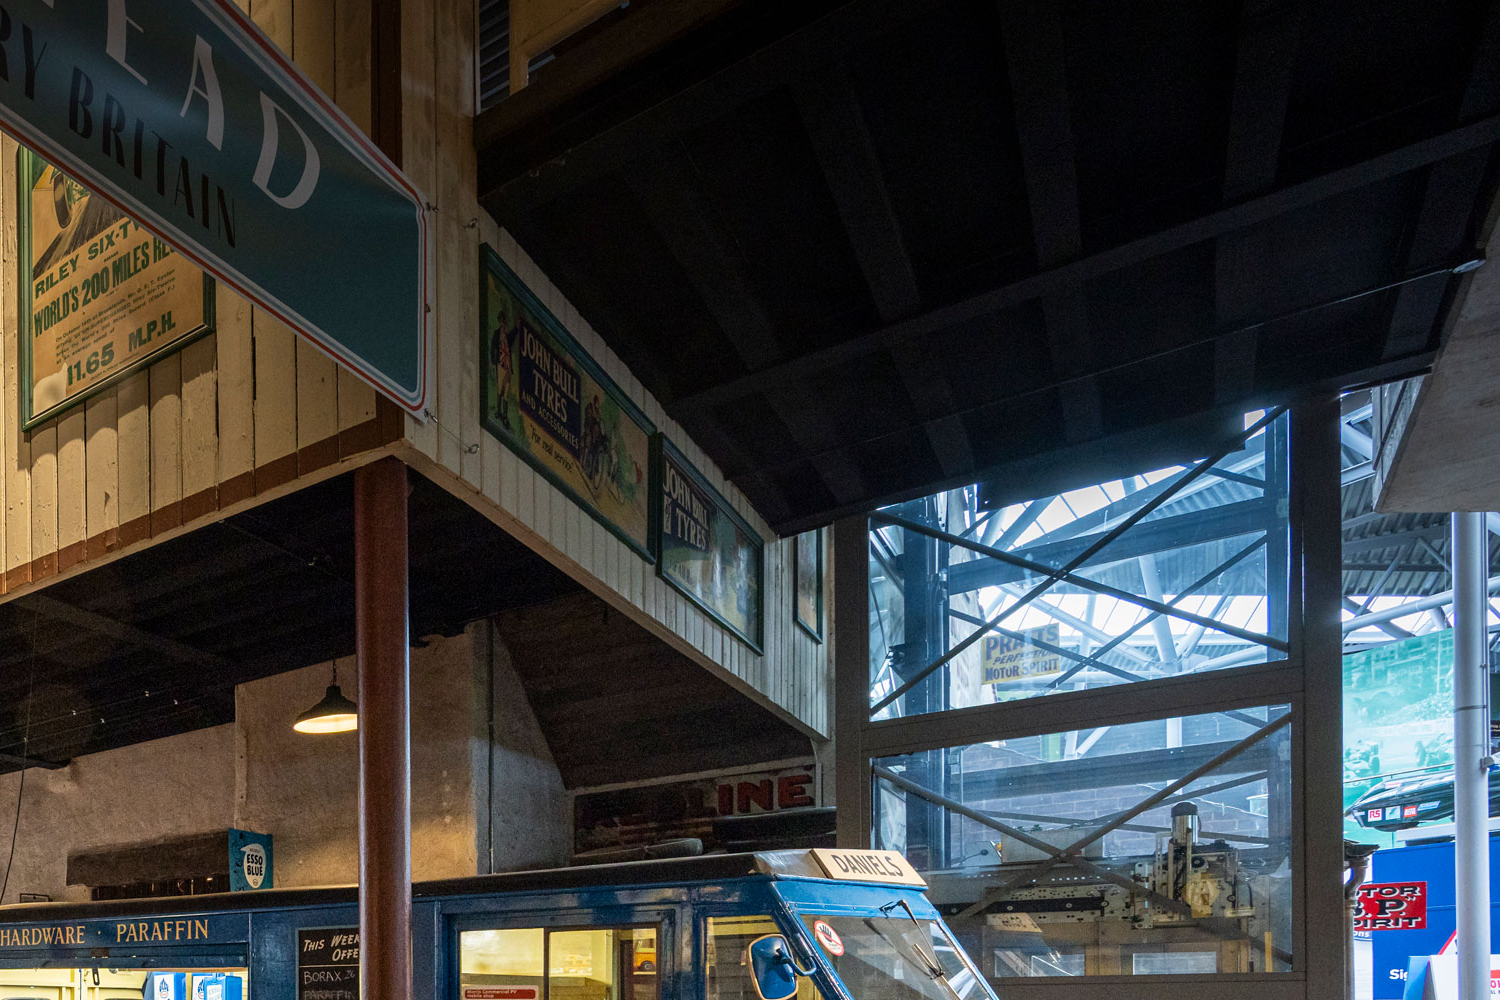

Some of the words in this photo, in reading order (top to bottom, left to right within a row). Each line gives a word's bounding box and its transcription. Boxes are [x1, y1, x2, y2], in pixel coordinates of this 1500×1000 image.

[43, 0, 321, 208] EAD
[69, 65, 236, 250] BRITAIN
[34, 285, 79, 338] WORLD'S
[82, 267, 110, 308] 200
[112, 240, 150, 288] MILES
[35, 254, 79, 299] RILEY
[521, 328, 550, 376] JOHN
[553, 358, 580, 405] BULL
[533, 369, 568, 423] TYRES
[522, 391, 536, 410] AND
[538, 406, 580, 450] ACCESSORIES
[542, 441, 553, 456] real
[663, 460, 692, 513] JOHN
[676, 507, 707, 551] TYRES
[986, 625, 1057, 661] PRATS
[985, 665, 1020, 681] MOTOR
[1021, 658, 1060, 676] SPIRIT
[1369, 810, 1381, 819] RS
[247, 854, 263, 865] ESSO
[247, 865, 263, 876] BLUE
[831, 854, 903, 877] DANIELS
[0, 926, 86, 947] HARDWARE
[116, 919, 209, 943] PARAFFIN
[303, 940, 325, 952] THIS
[304, 971, 342, 984] BORAX
